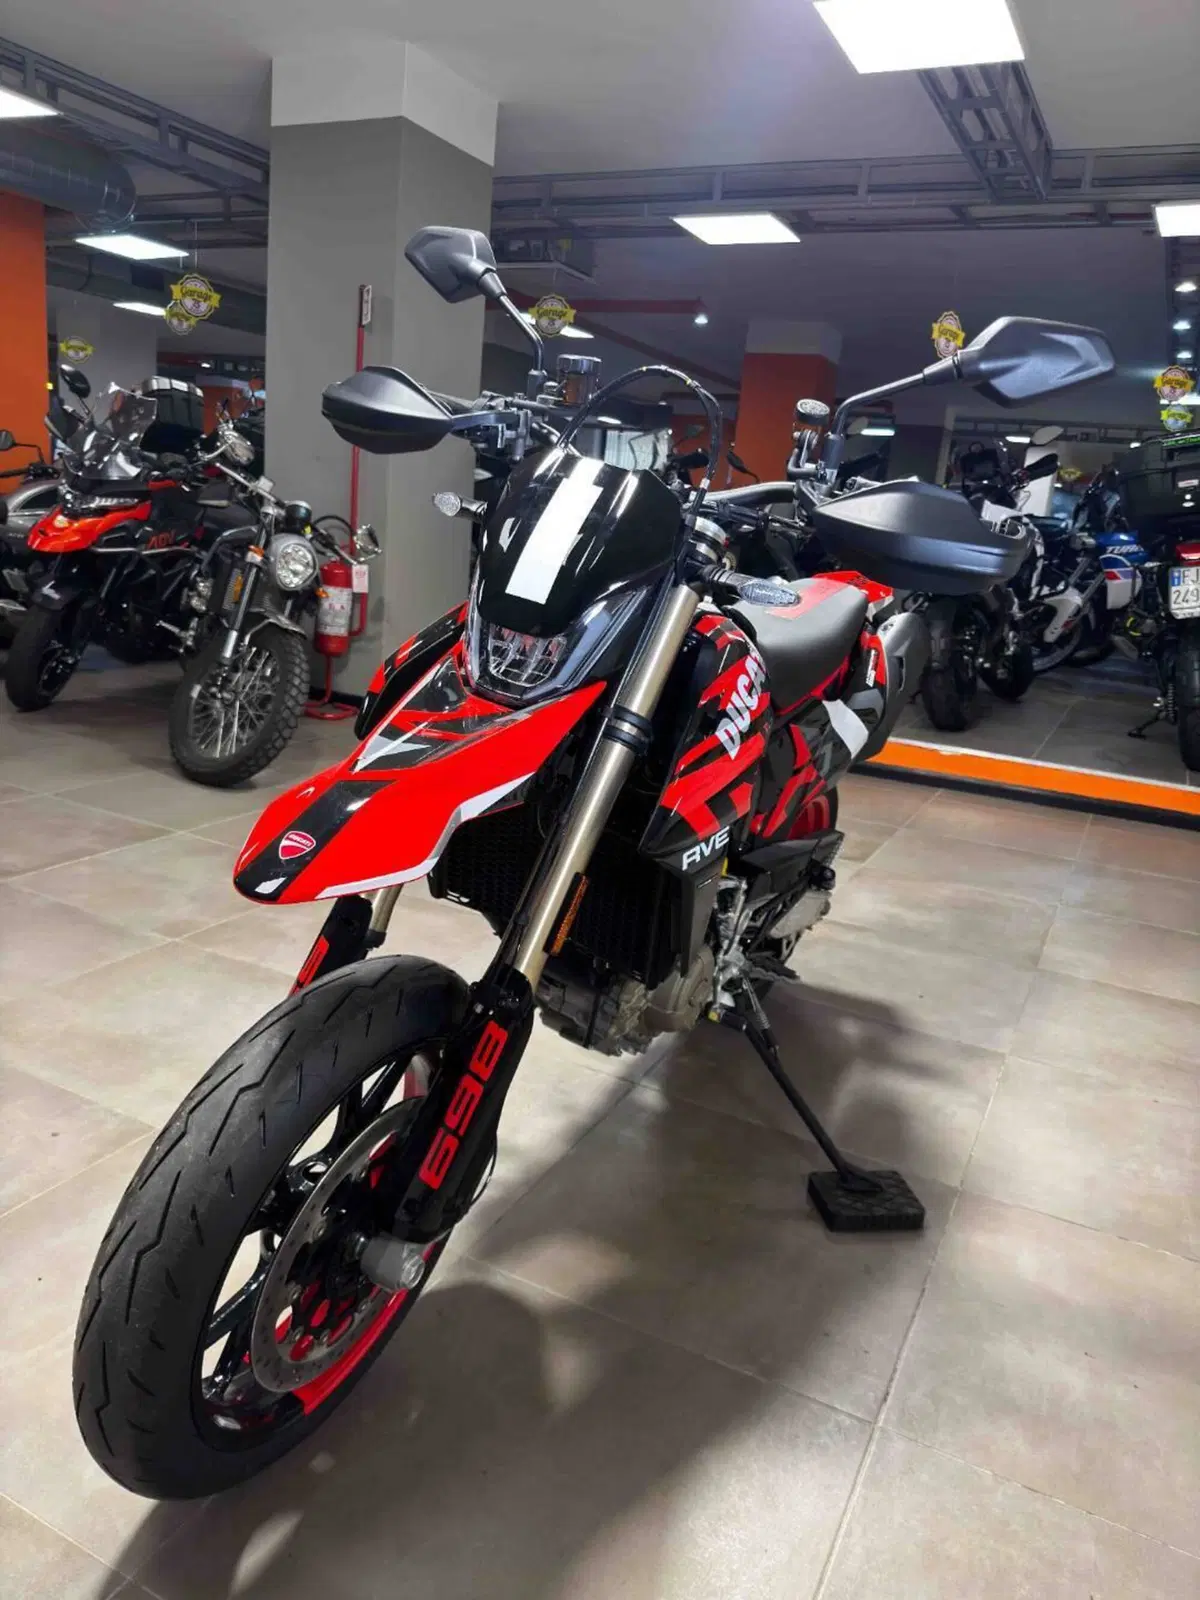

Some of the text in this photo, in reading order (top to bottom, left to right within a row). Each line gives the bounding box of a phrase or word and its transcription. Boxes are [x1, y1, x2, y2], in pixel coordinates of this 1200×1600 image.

[288, 833, 314, 847] DUCATI
[682, 825, 730, 871] RVE
[418, 1020, 509, 1191] 698
